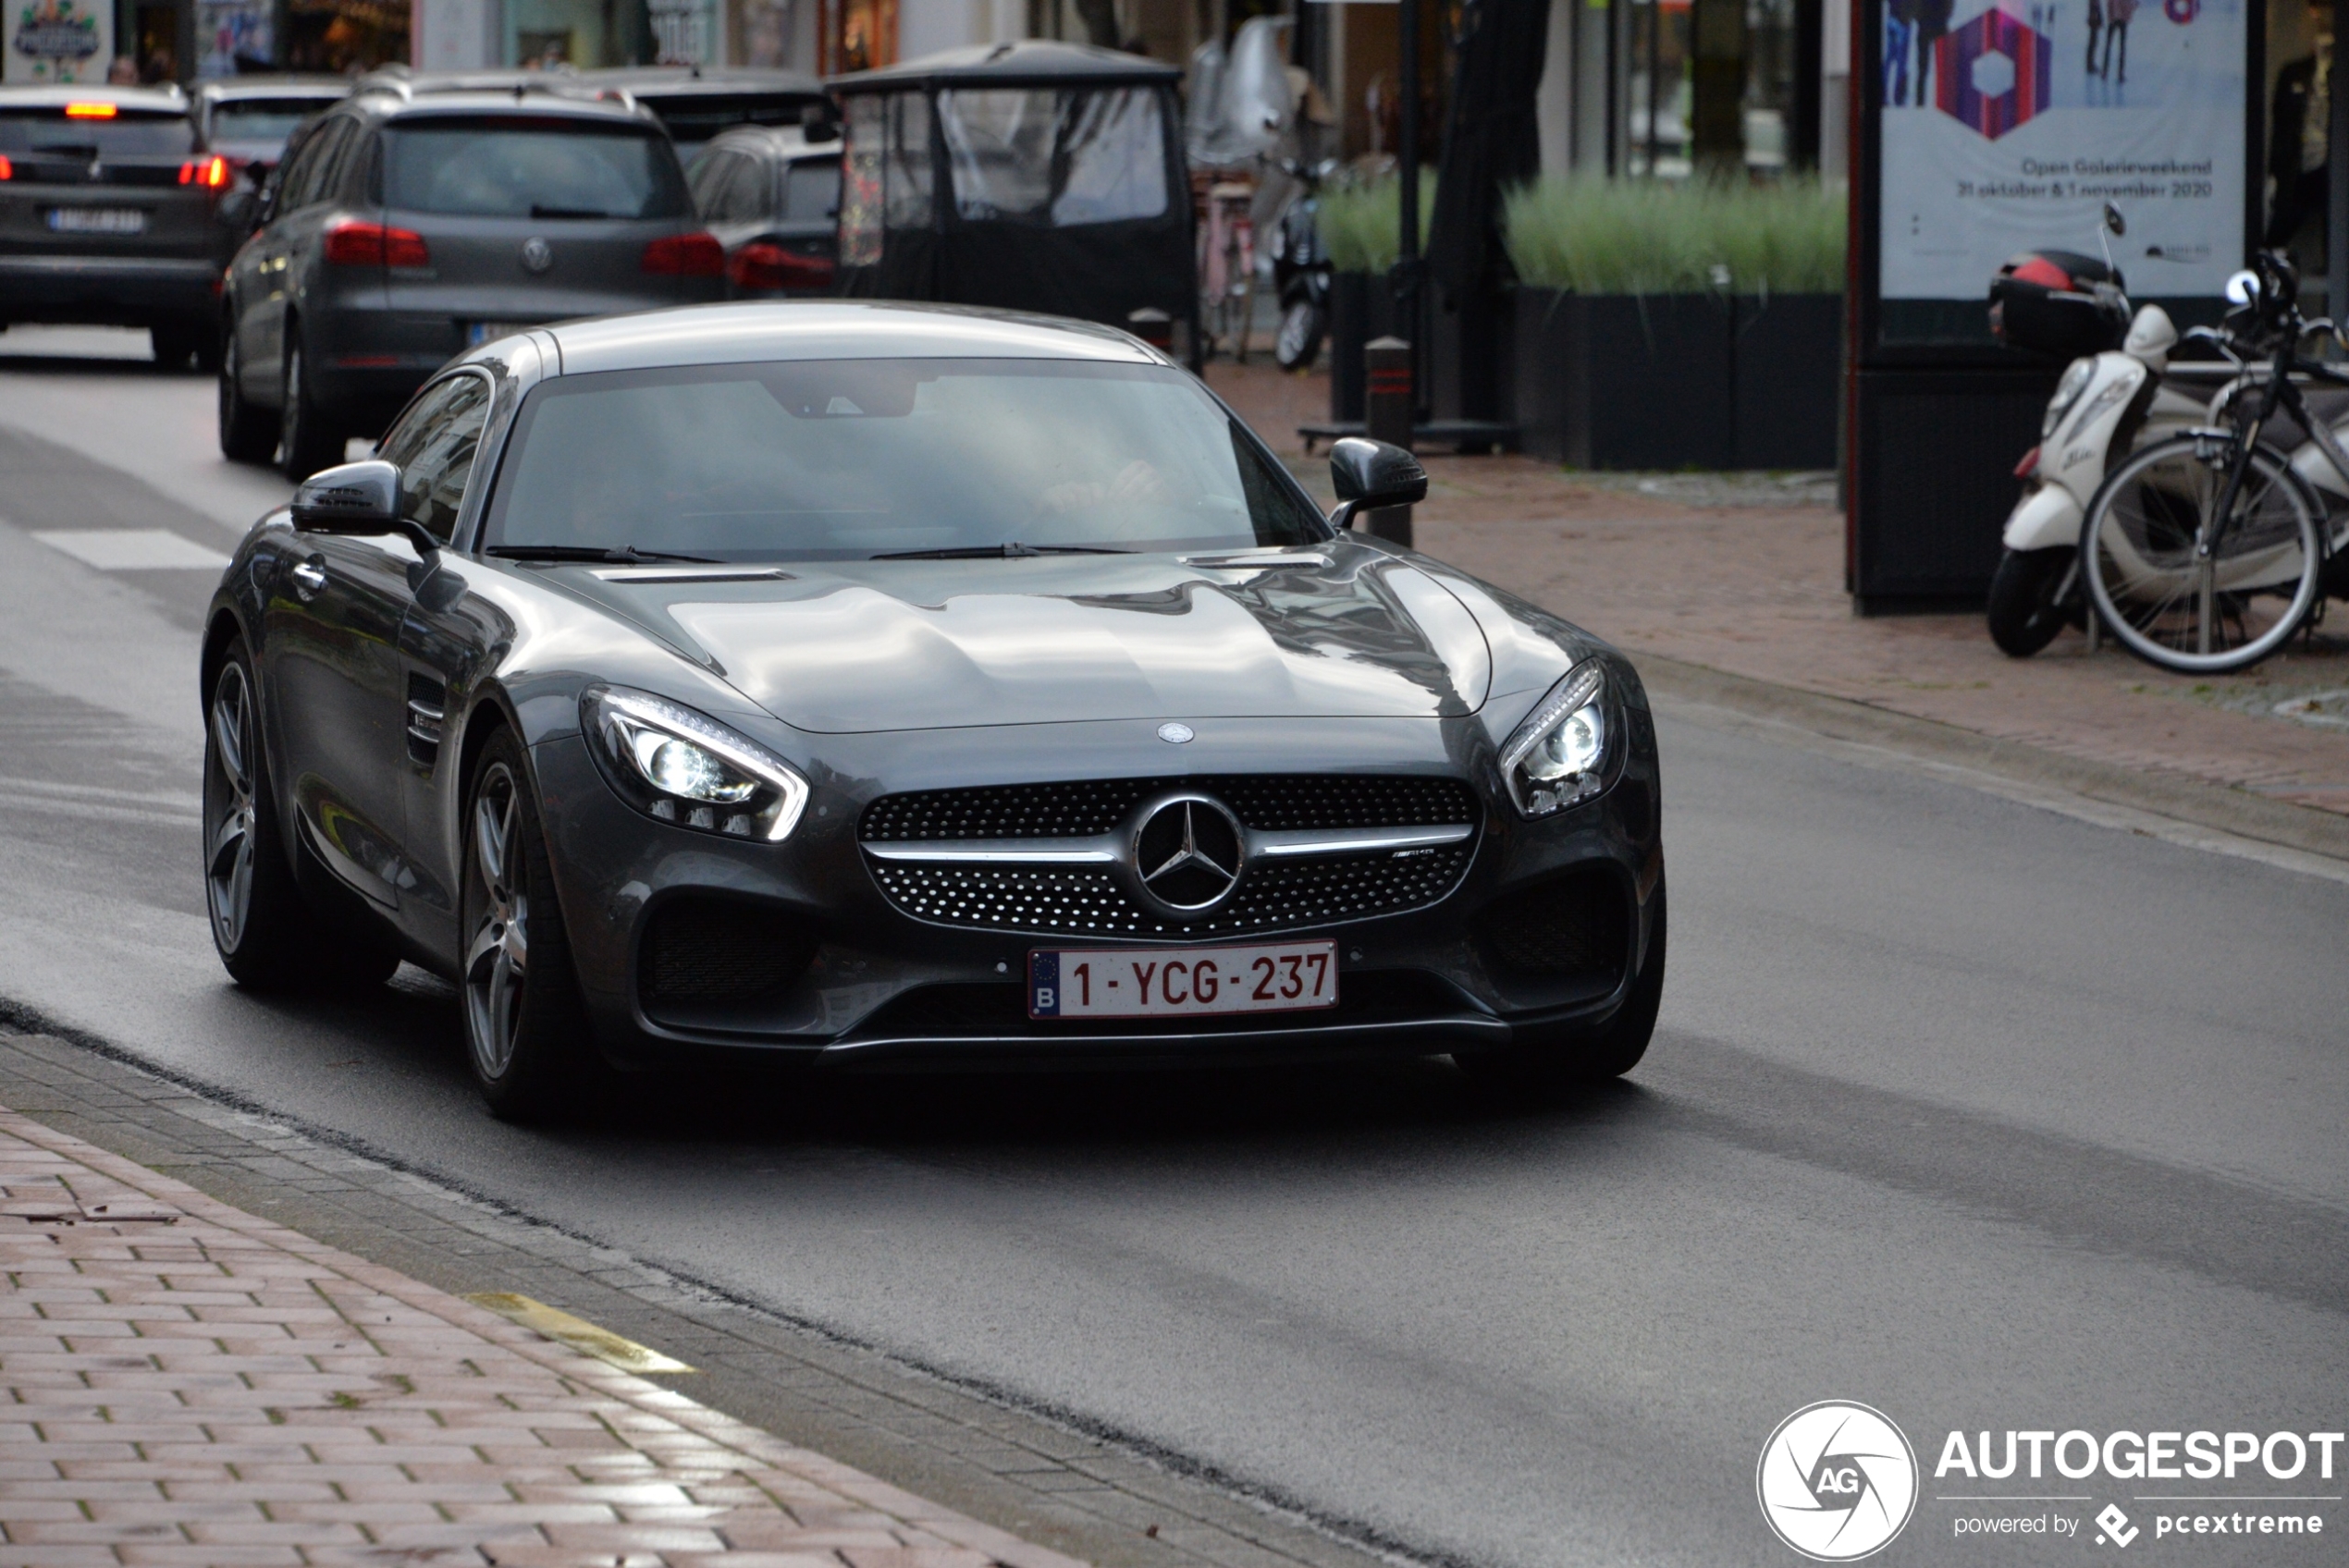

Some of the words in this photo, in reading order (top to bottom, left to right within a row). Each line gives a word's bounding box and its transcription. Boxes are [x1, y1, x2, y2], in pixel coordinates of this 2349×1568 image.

[2022, 159, 2070, 177] Open
[2074, 158, 2212, 175] Galerieweekend
[1978, 181, 2046, 197] oktober
[2081, 181, 2166, 197] november
[2171, 181, 2212, 197] 2020
[1074, 953, 1329, 1006] 1-YCG-237
[1037, 987, 1054, 1008] B
